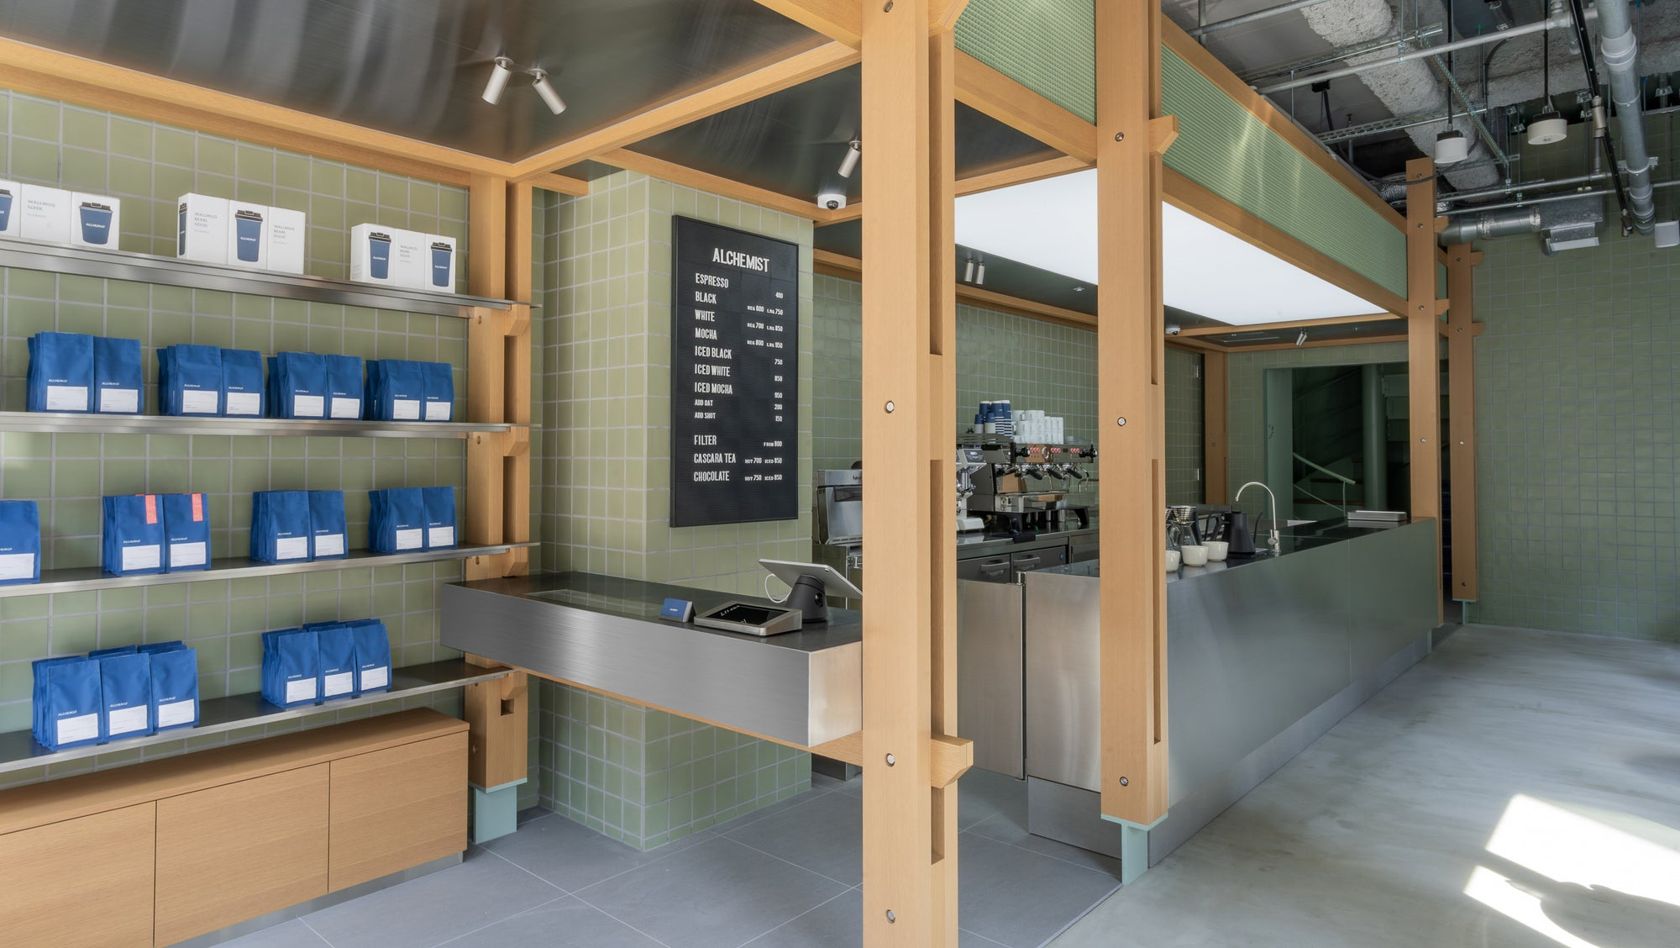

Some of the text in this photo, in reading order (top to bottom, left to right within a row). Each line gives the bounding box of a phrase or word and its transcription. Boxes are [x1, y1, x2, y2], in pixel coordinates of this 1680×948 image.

[712, 248, 770, 272] ALCHEMIST
[695, 273, 729, 288] ESPRESSO
[695, 291, 717, 304] BLACK
[695, 309, 715, 322] WHITE
[695, 327, 717, 340] MOCHA
[695, 345, 710, 357] ICED
[711, 347, 732, 359] BLACK
[695, 364, 710, 375] ICED
[711, 365, 730, 377] WHITE
[695, 382, 710, 393] ICED
[711, 383, 733, 394] MOCHA
[694, 435, 717, 445] FILTER
[694, 453, 723, 463] CASCARA
[724, 453, 736, 463] TEA
[694, 471, 730, 482] CHOCOLATE
